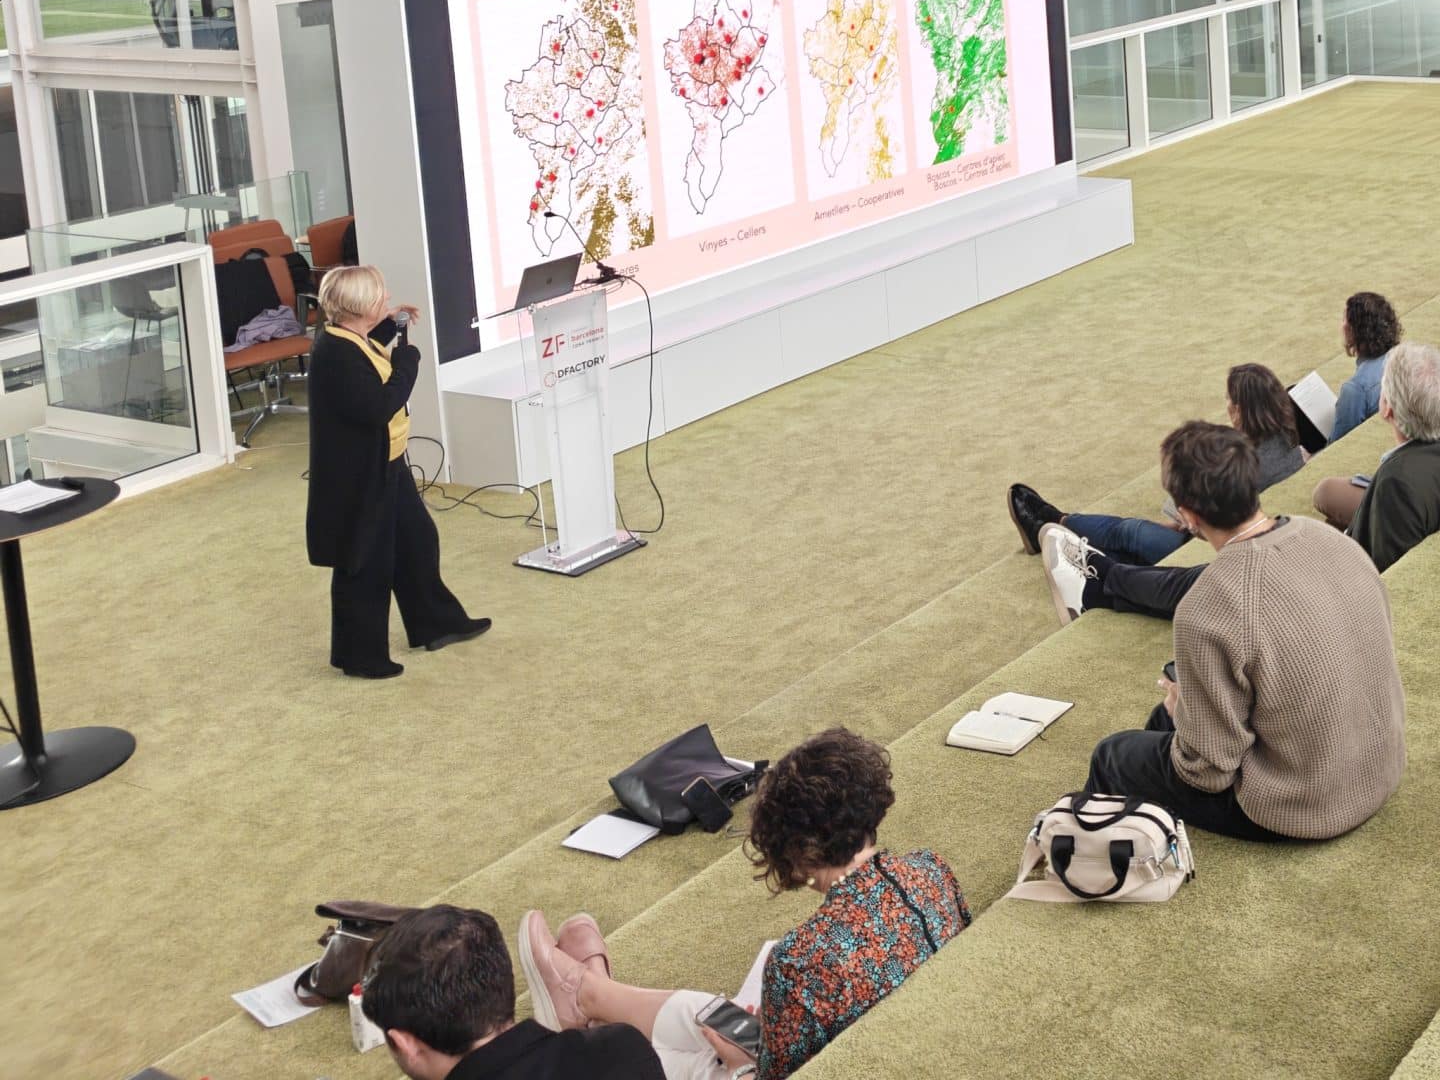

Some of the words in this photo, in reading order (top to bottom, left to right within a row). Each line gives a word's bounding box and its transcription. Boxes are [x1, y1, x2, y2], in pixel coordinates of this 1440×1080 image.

[857, 187, 905, 208] Cooperatives
[698, 236, 728, 253] Vinyes
[737, 225, 767, 242] Cellers
[541, 333, 565, 359] ZF
[557, 355, 605, 379] DFACTORY
